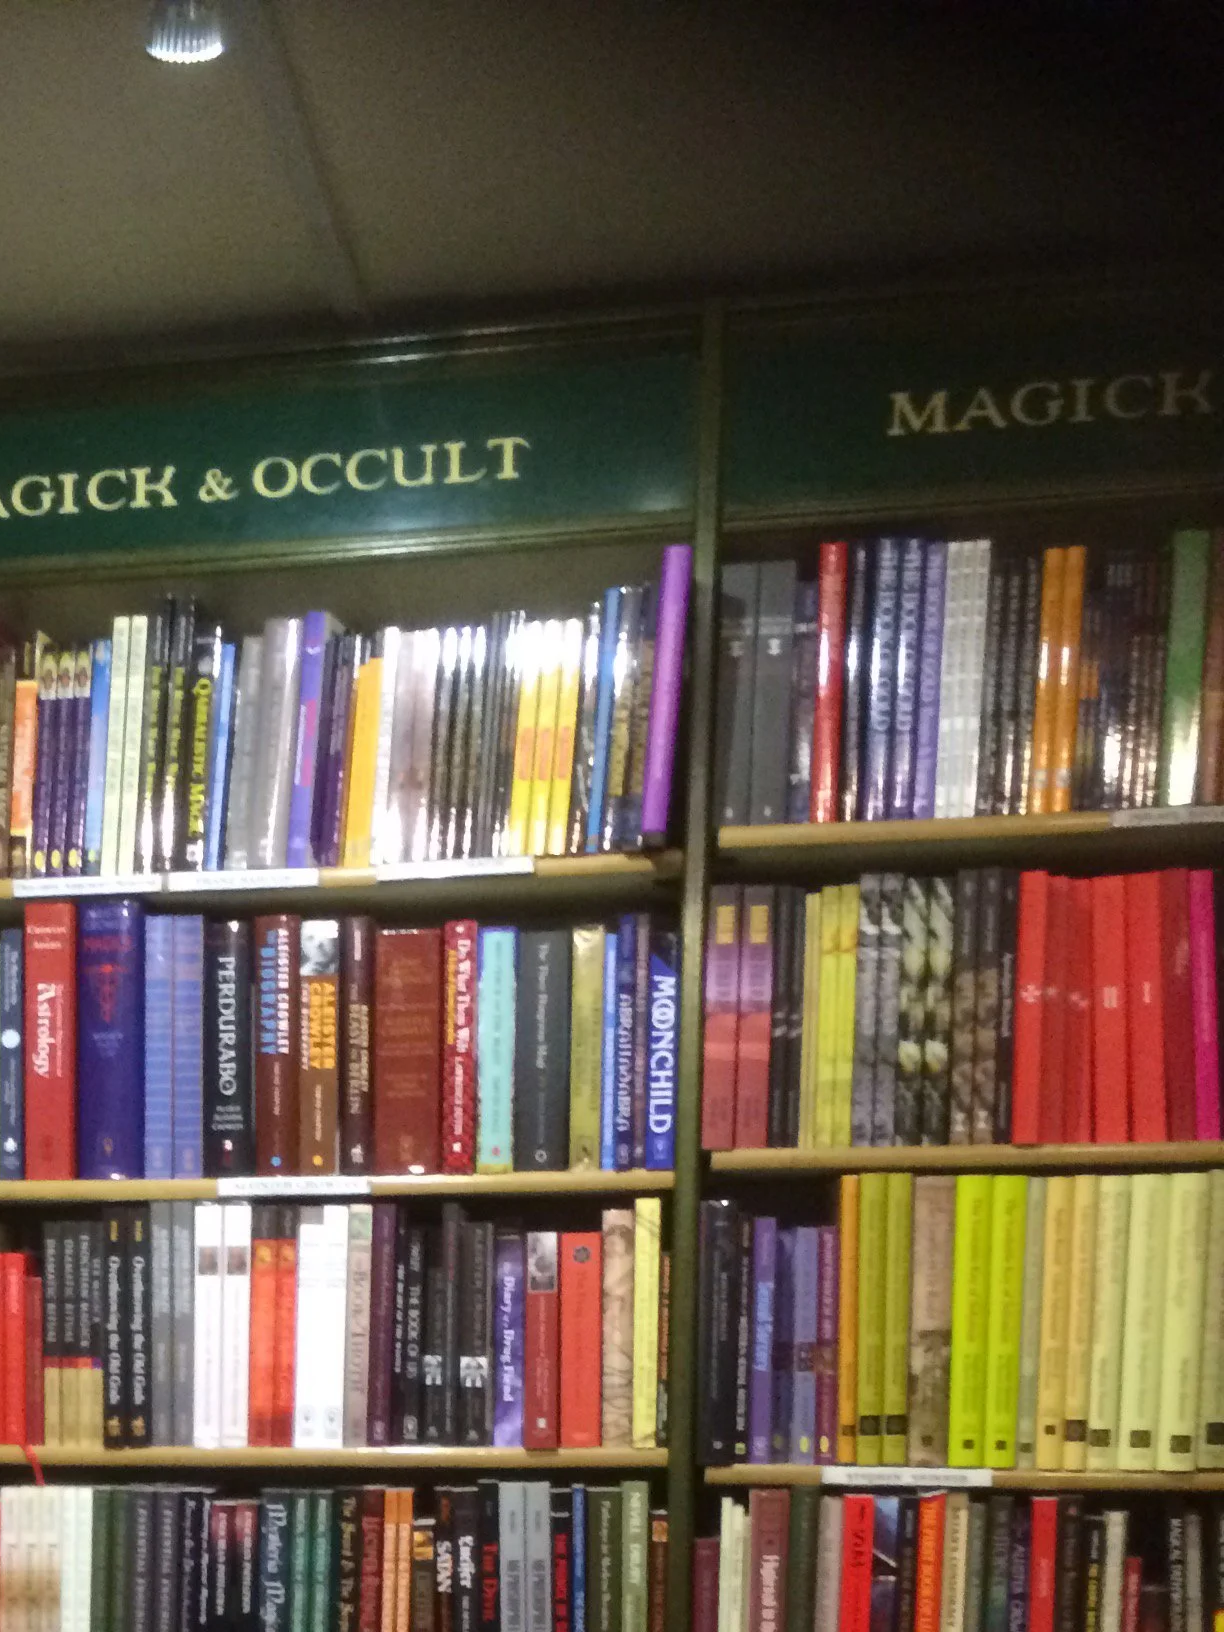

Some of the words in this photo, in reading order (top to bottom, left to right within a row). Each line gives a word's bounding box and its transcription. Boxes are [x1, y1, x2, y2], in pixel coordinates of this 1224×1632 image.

[886, 369, 1214, 437] MAGICK
[198, 468, 239, 503] &
[252, 436, 530, 499] OCCULT
[34, 983, 57, 1078] Astrology
[217, 956, 236, 1096] PERDURABO
[309, 982, 322, 1070] CROWLEY
[323, 982, 336, 1070] ALEISTER
[650, 974, 675, 1133] MOONCHILD
[436, 1540, 453, 1593] SATAN
